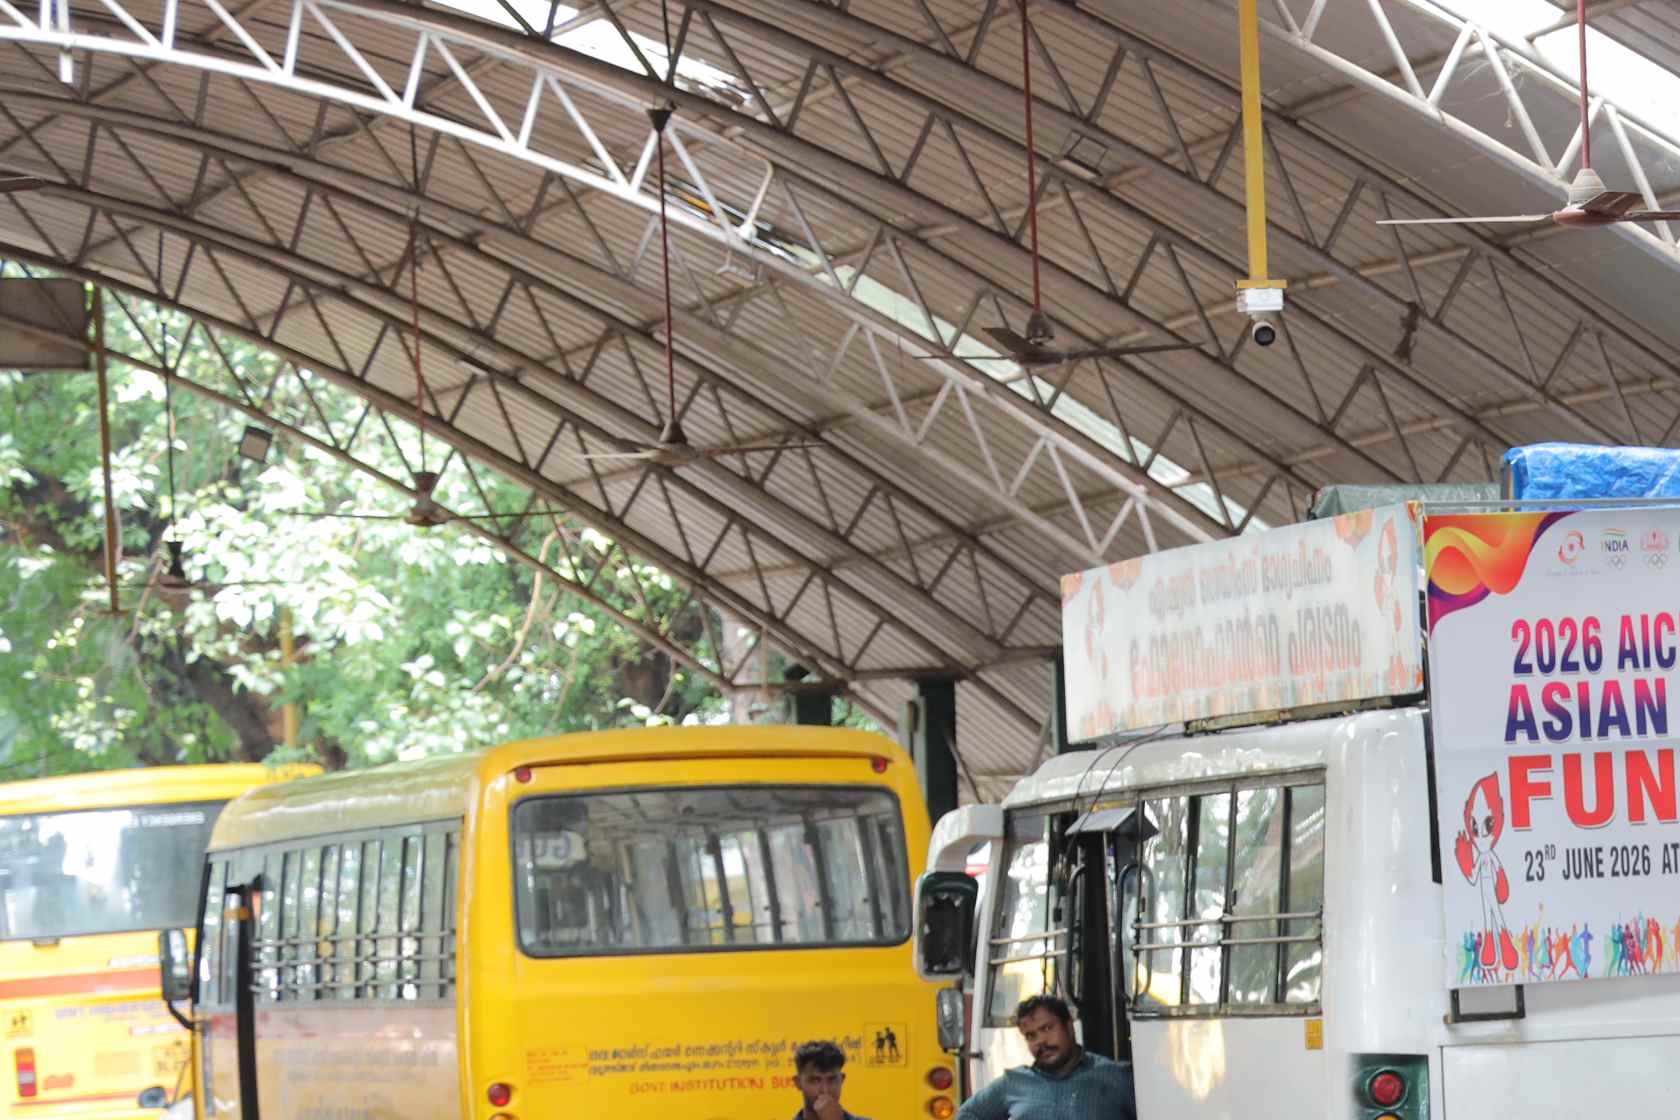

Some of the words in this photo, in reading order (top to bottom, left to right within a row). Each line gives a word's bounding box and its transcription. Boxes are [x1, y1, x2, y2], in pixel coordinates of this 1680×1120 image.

[1511, 616, 1602, 675] 2026
[1504, 678, 1669, 744] ASIAN
[1508, 748, 1678, 830] FUN
[1562, 847, 1604, 881] JUNE
[1610, 844, 1651, 877] 2026
[1661, 843, 1680, 875] AT
